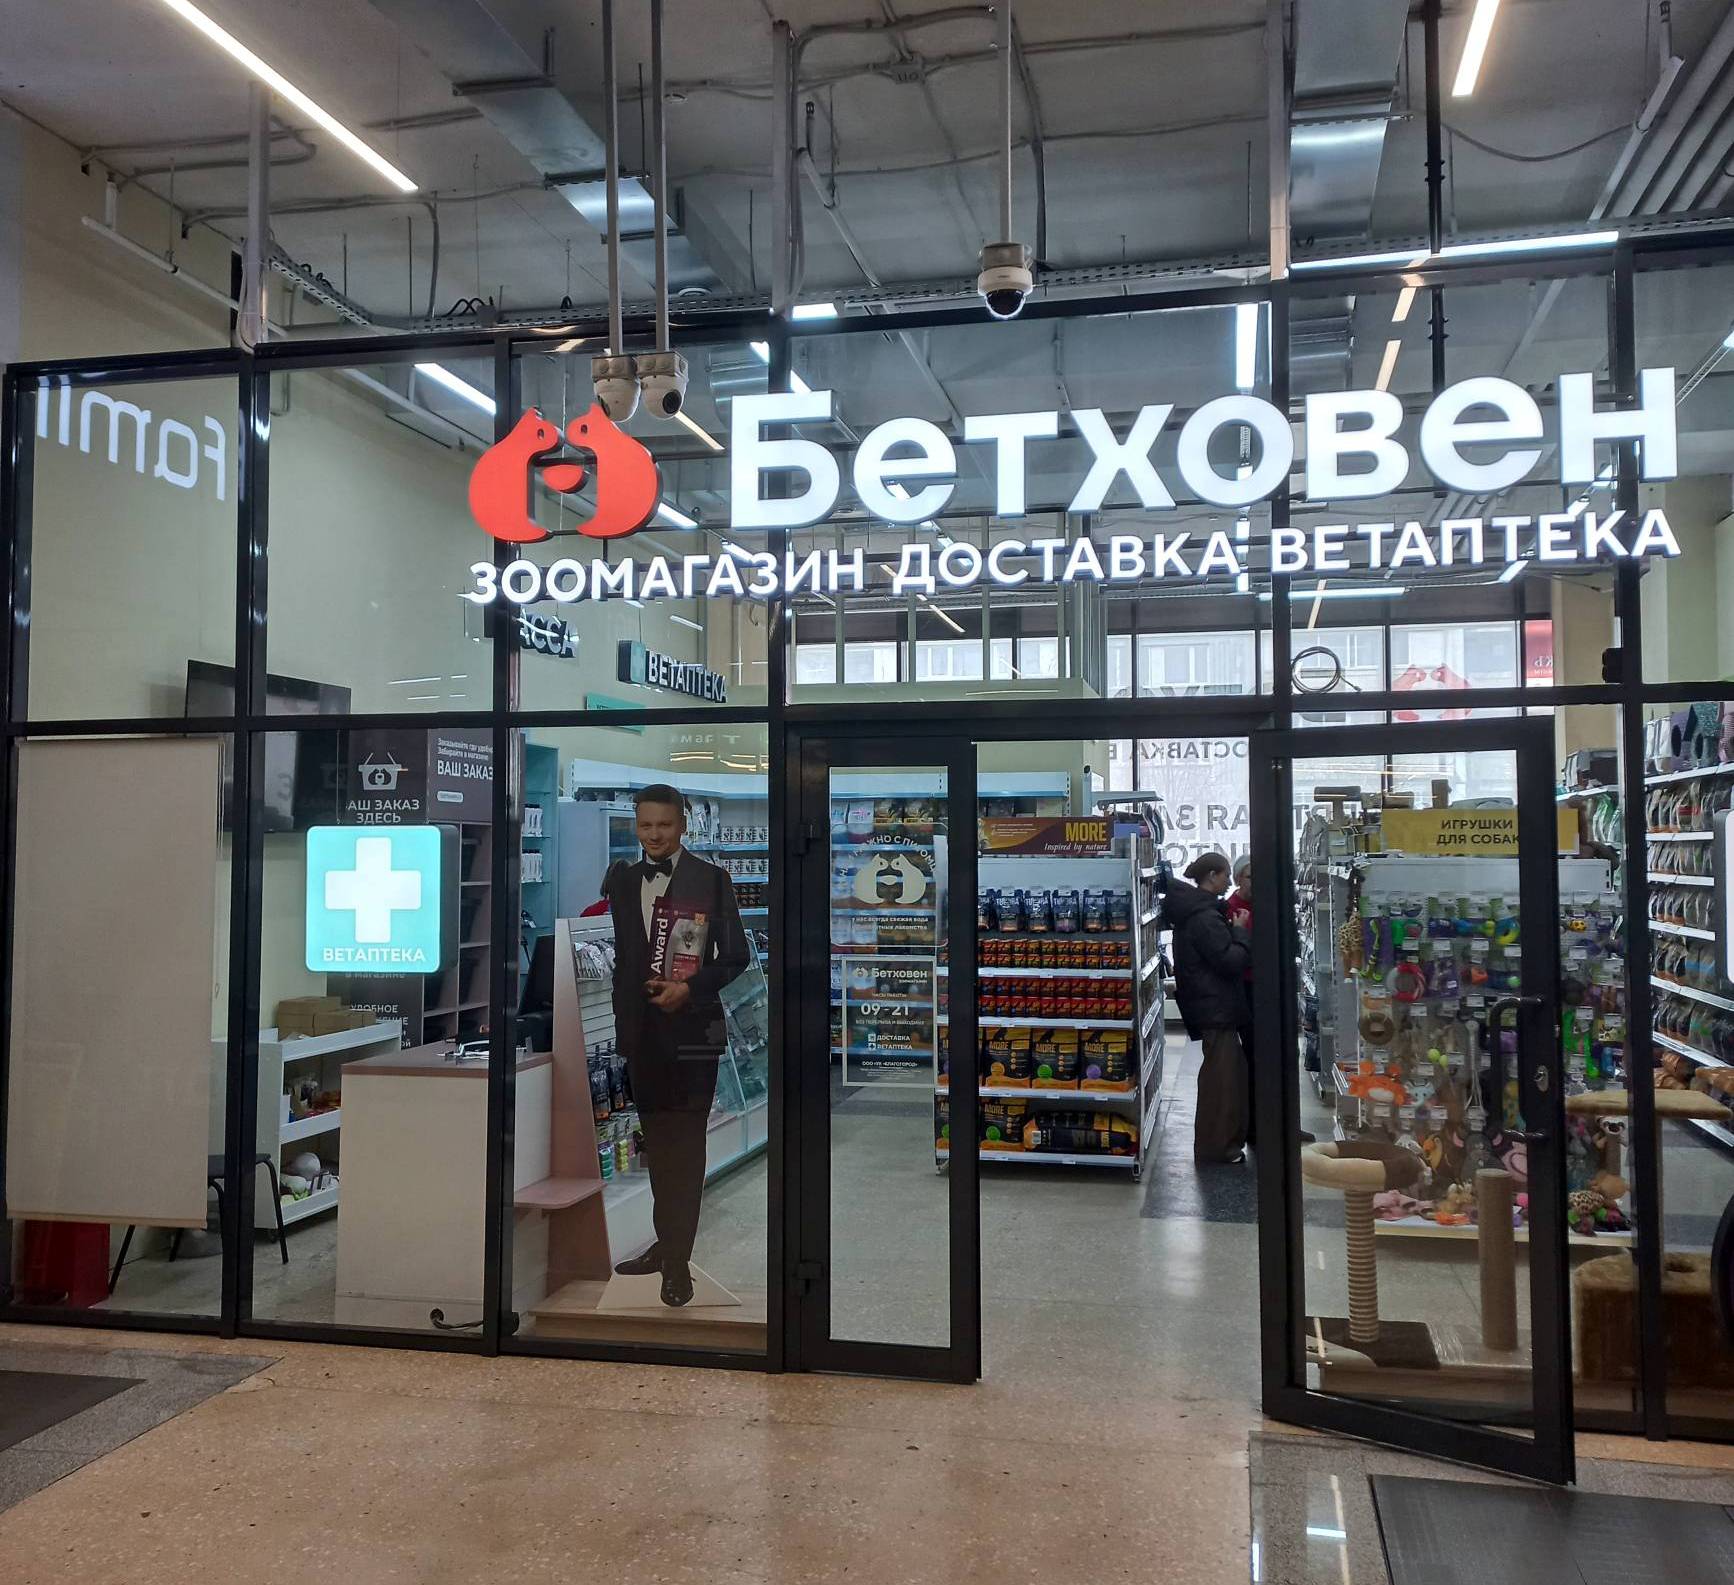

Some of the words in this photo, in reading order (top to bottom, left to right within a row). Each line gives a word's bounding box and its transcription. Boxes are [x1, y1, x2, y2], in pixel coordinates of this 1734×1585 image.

[731, 366, 1679, 531] Бетховен
[469, 547, 865, 604] ЗООМАГАЗИН
[892, 529, 1242, 595] ДОСТАВКА
[1270, 508, 1682, 574] ВЕТАПТЕКА
[520, 605, 578, 658] АССА
[648, 651, 728, 702] ВЕТАПТЕКА
[437, 760, 461, 777] ВАШ
[463, 763, 493, 780] ЗАКАЗ
[347, 800, 372, 811] АШ
[374, 799, 420, 811] ЗАКАЗ
[356, 812, 401, 824] ЗДЕСЬ
[1441, 819, 1513, 830] ИГРУШКИ
[1065, 822, 1107, 842] MORE
[1436, 834, 1467, 846] ДЛЯ
[1044, 842, 1071, 853] Inspired
[1073, 843, 1082, 853] by
[1085, 843, 1107, 851] nature
[323, 947, 426, 962] ВЕТАПТЕКА
[650, 918, 669, 974] Award
[871, 967, 928, 978] Бетховен
